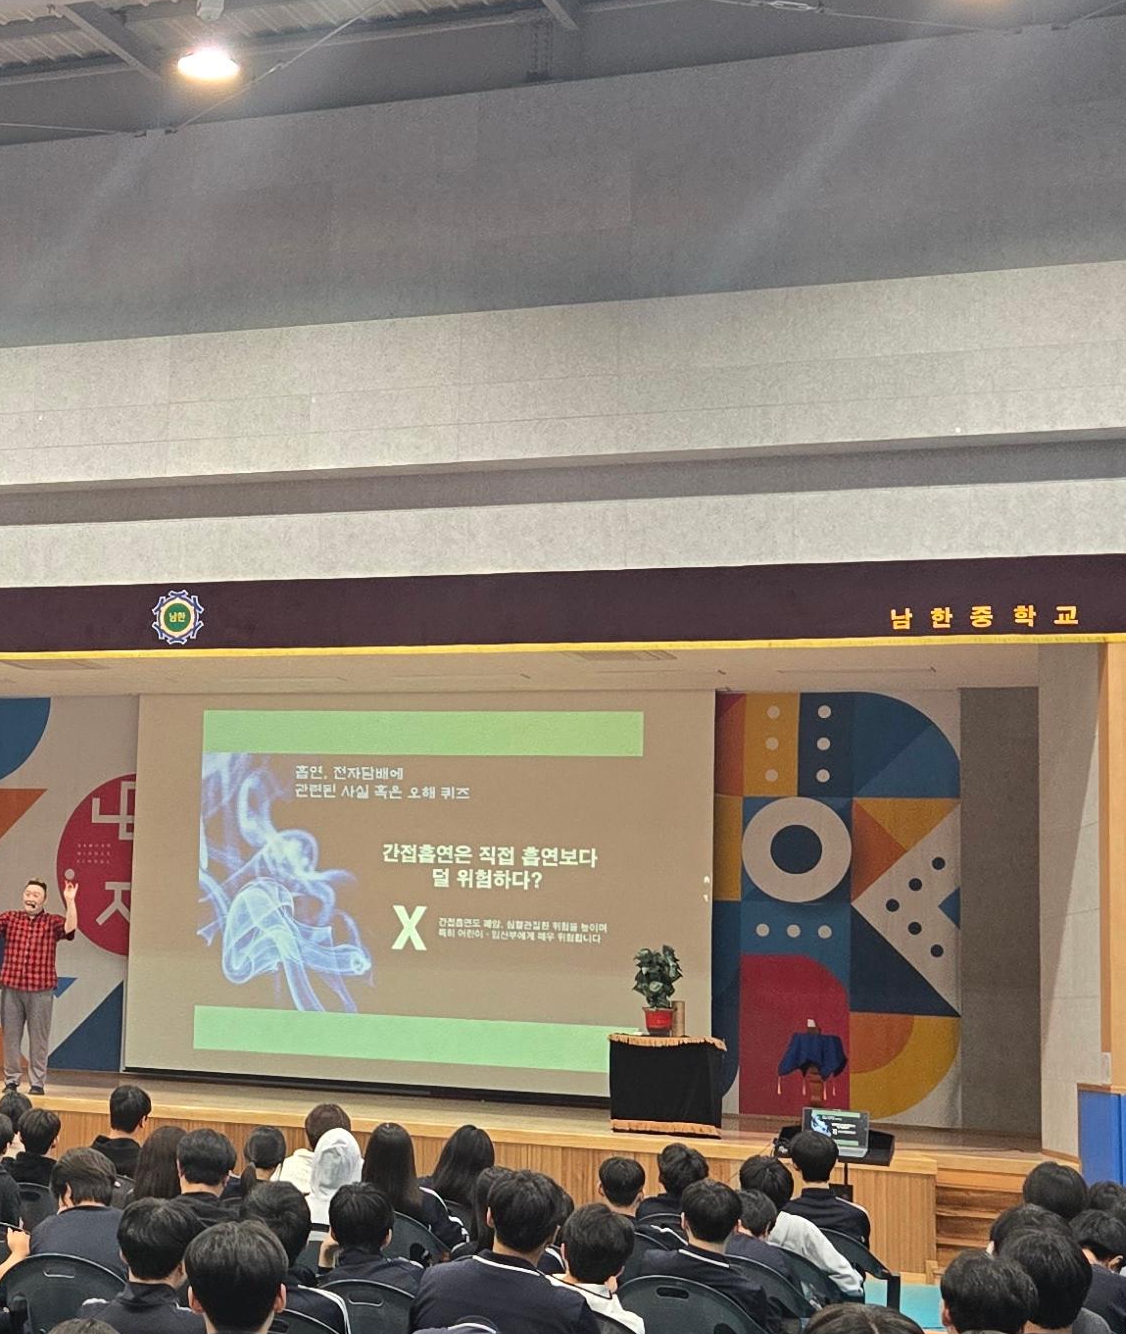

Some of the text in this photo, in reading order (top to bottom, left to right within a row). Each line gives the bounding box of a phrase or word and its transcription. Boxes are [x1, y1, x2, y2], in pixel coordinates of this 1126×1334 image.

[890, 604, 1079, 630] 남한중학교
[333, 766, 404, 781] 전자담배에
[295, 783, 471, 800] 관련된 사실 혹은 오해 퀴즈
[382, 843, 598, 868] 간접흡연은 직접 흡연보다
[432, 868, 543, 890] 덜 위험하다?
[391, 905, 428, 951] X
